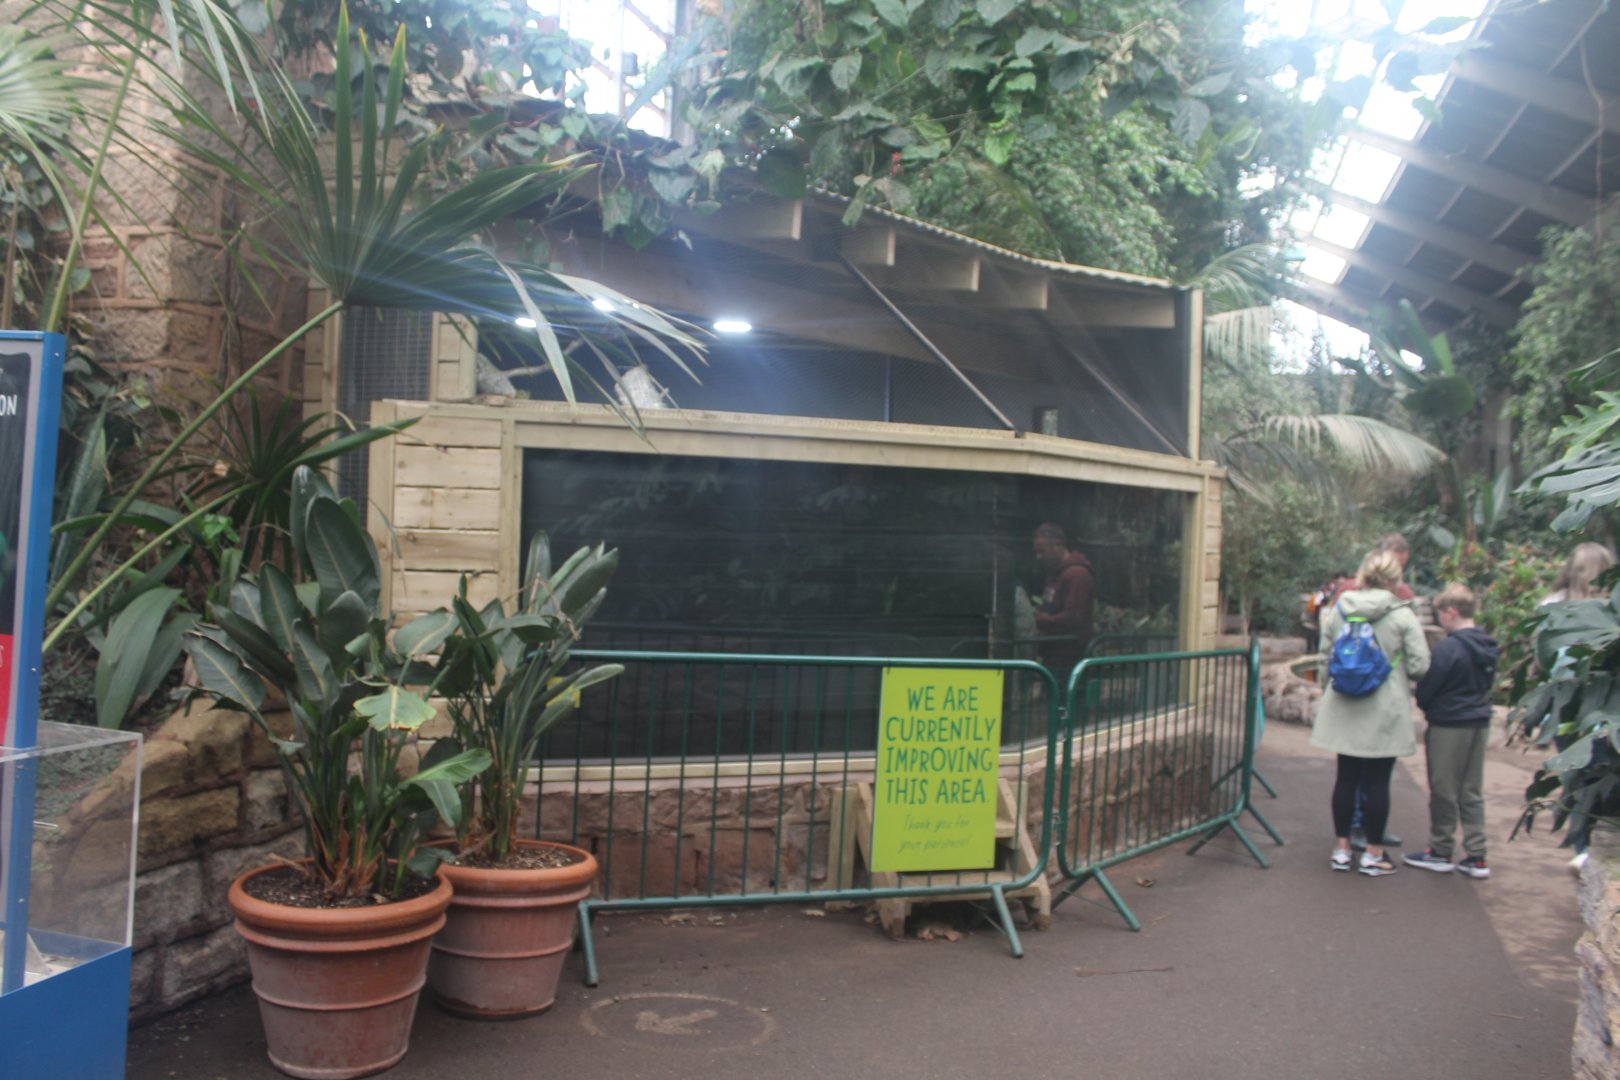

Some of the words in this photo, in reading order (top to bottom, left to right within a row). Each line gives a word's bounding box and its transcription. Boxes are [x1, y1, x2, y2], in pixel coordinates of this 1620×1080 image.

[907, 686, 935, 712] WE
[943, 686, 978, 711] ARE
[885, 716, 996, 742] CURRENTLY
[885, 746, 992, 773] IMPROVING
[886, 778, 928, 804] THIS
[936, 778, 986, 804] AREA
